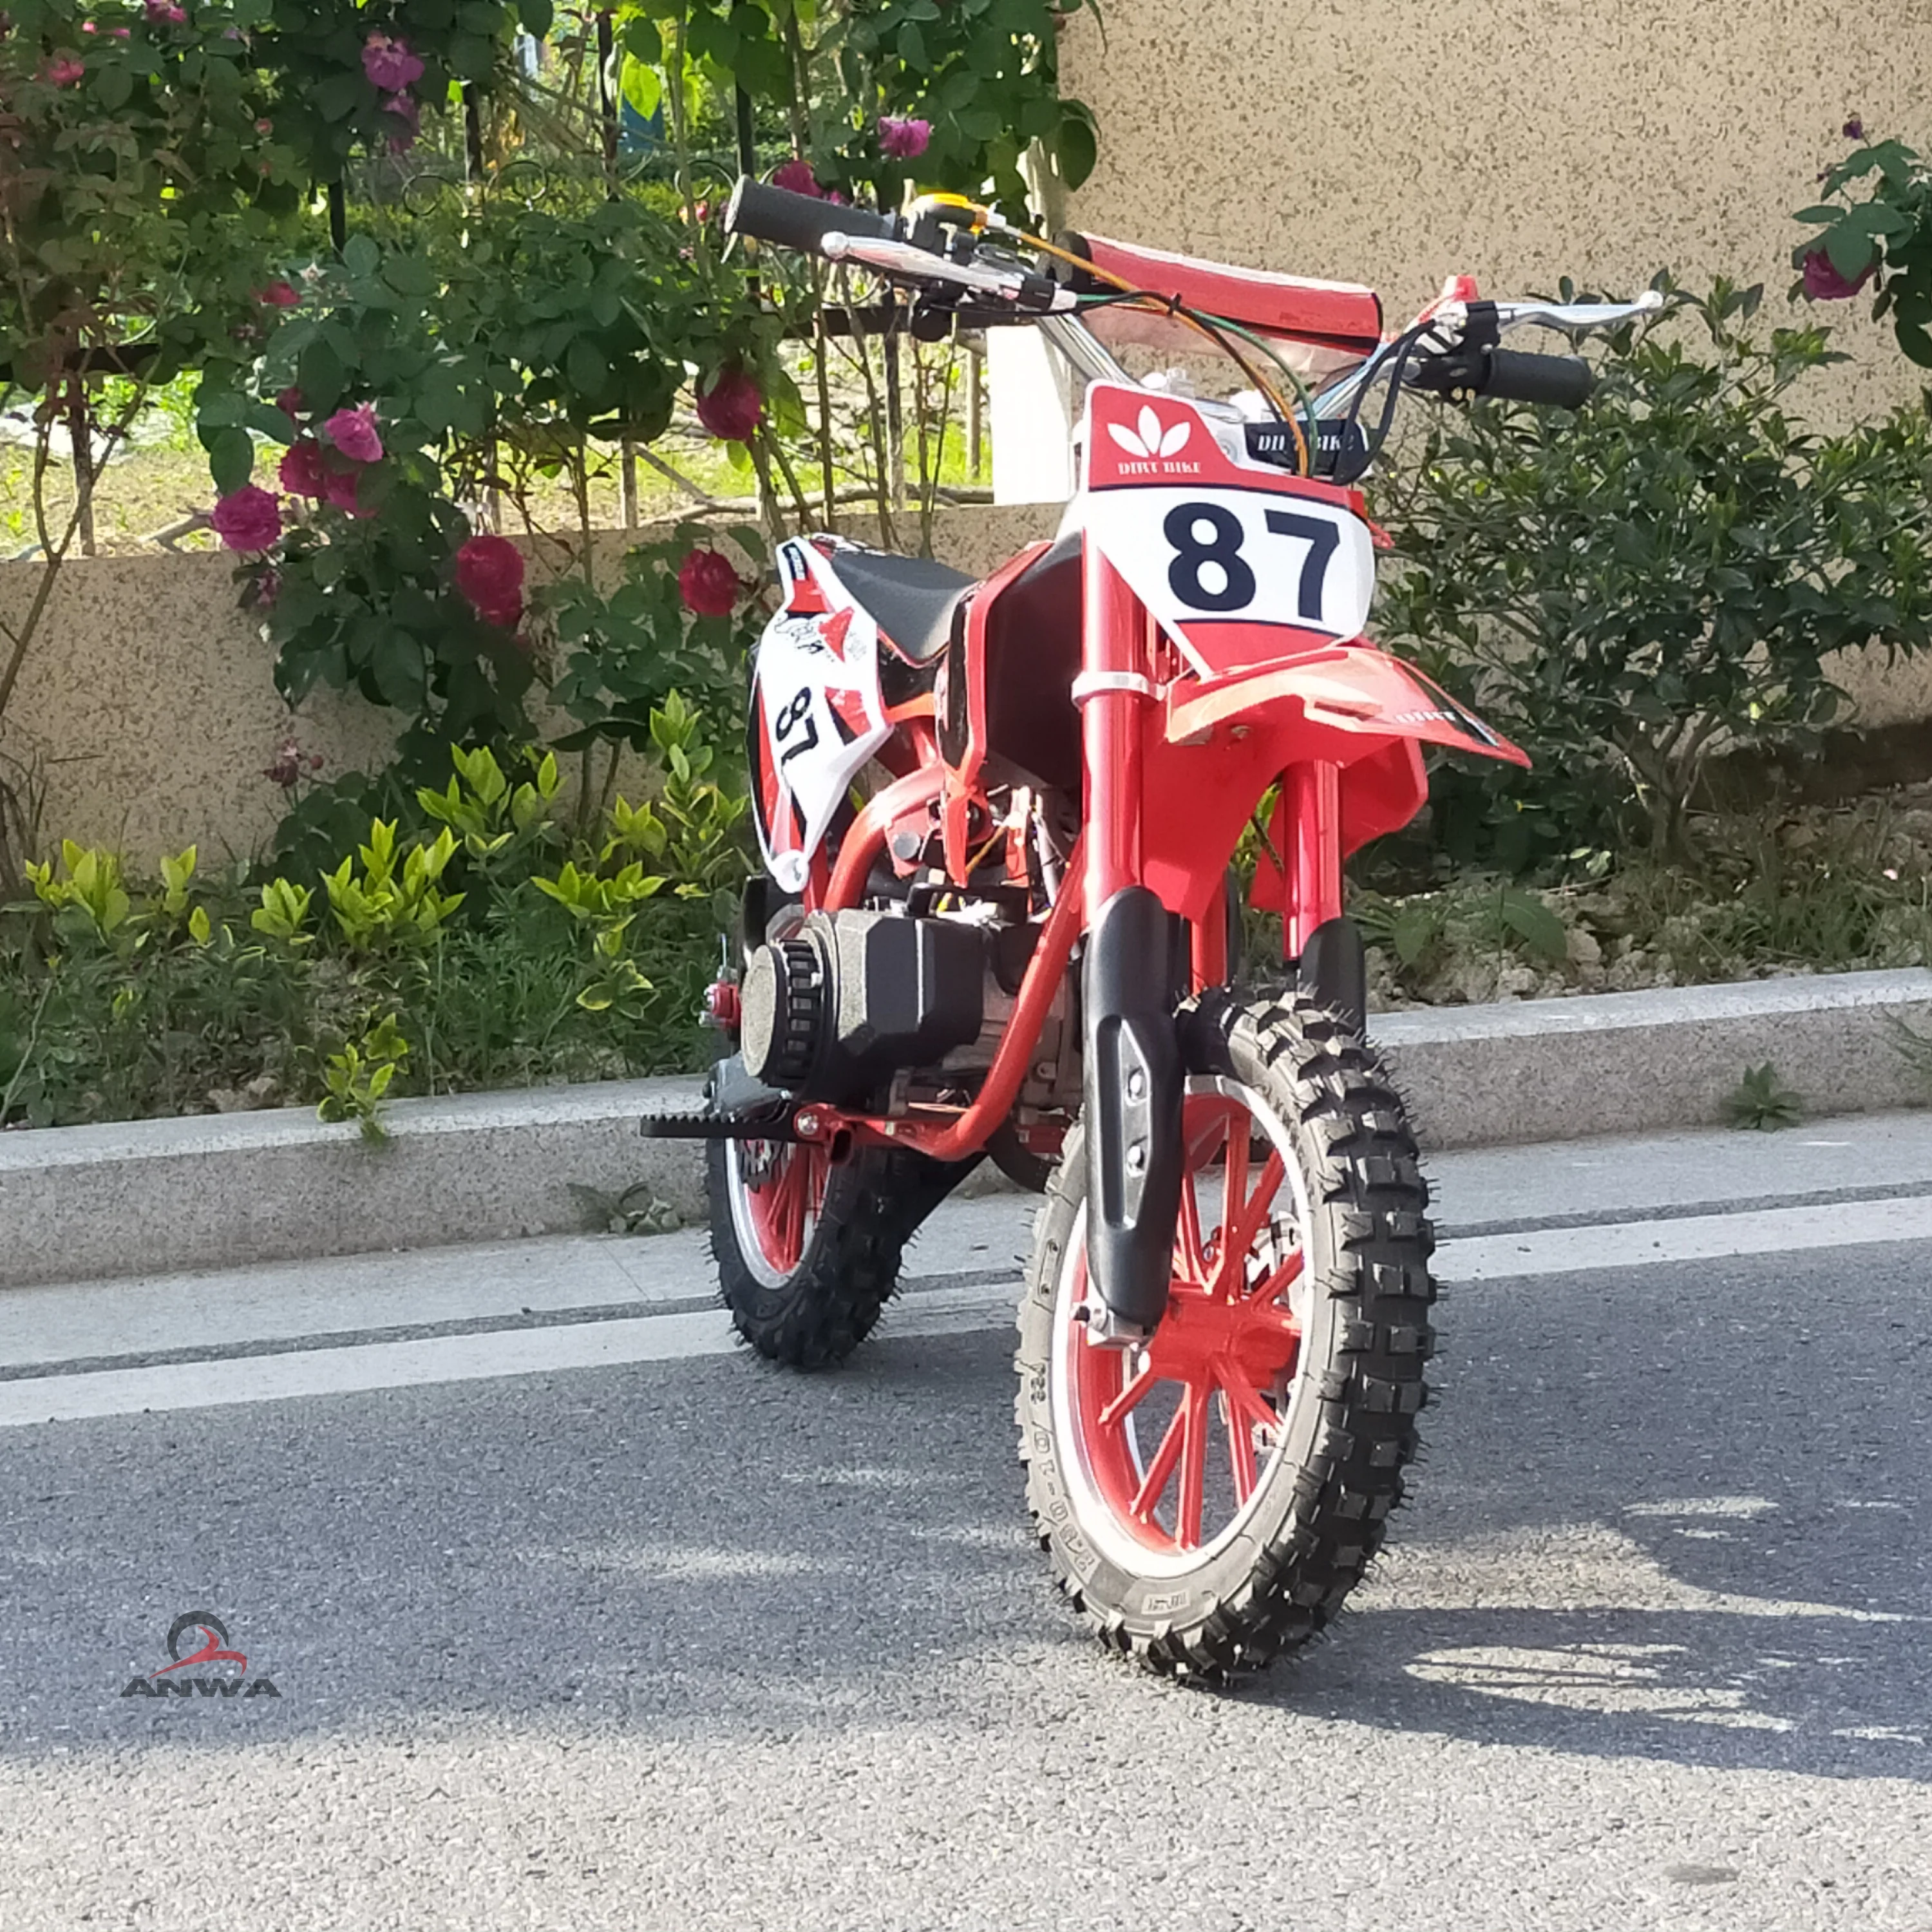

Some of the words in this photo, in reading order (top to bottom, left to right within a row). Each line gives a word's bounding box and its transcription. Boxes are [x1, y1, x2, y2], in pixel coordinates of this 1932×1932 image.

[1117, 461, 1158, 475] DIRT
[1162, 461, 1201, 475] BIKE
[1163, 502, 1341, 621] 87
[775, 686, 819, 762] 87
